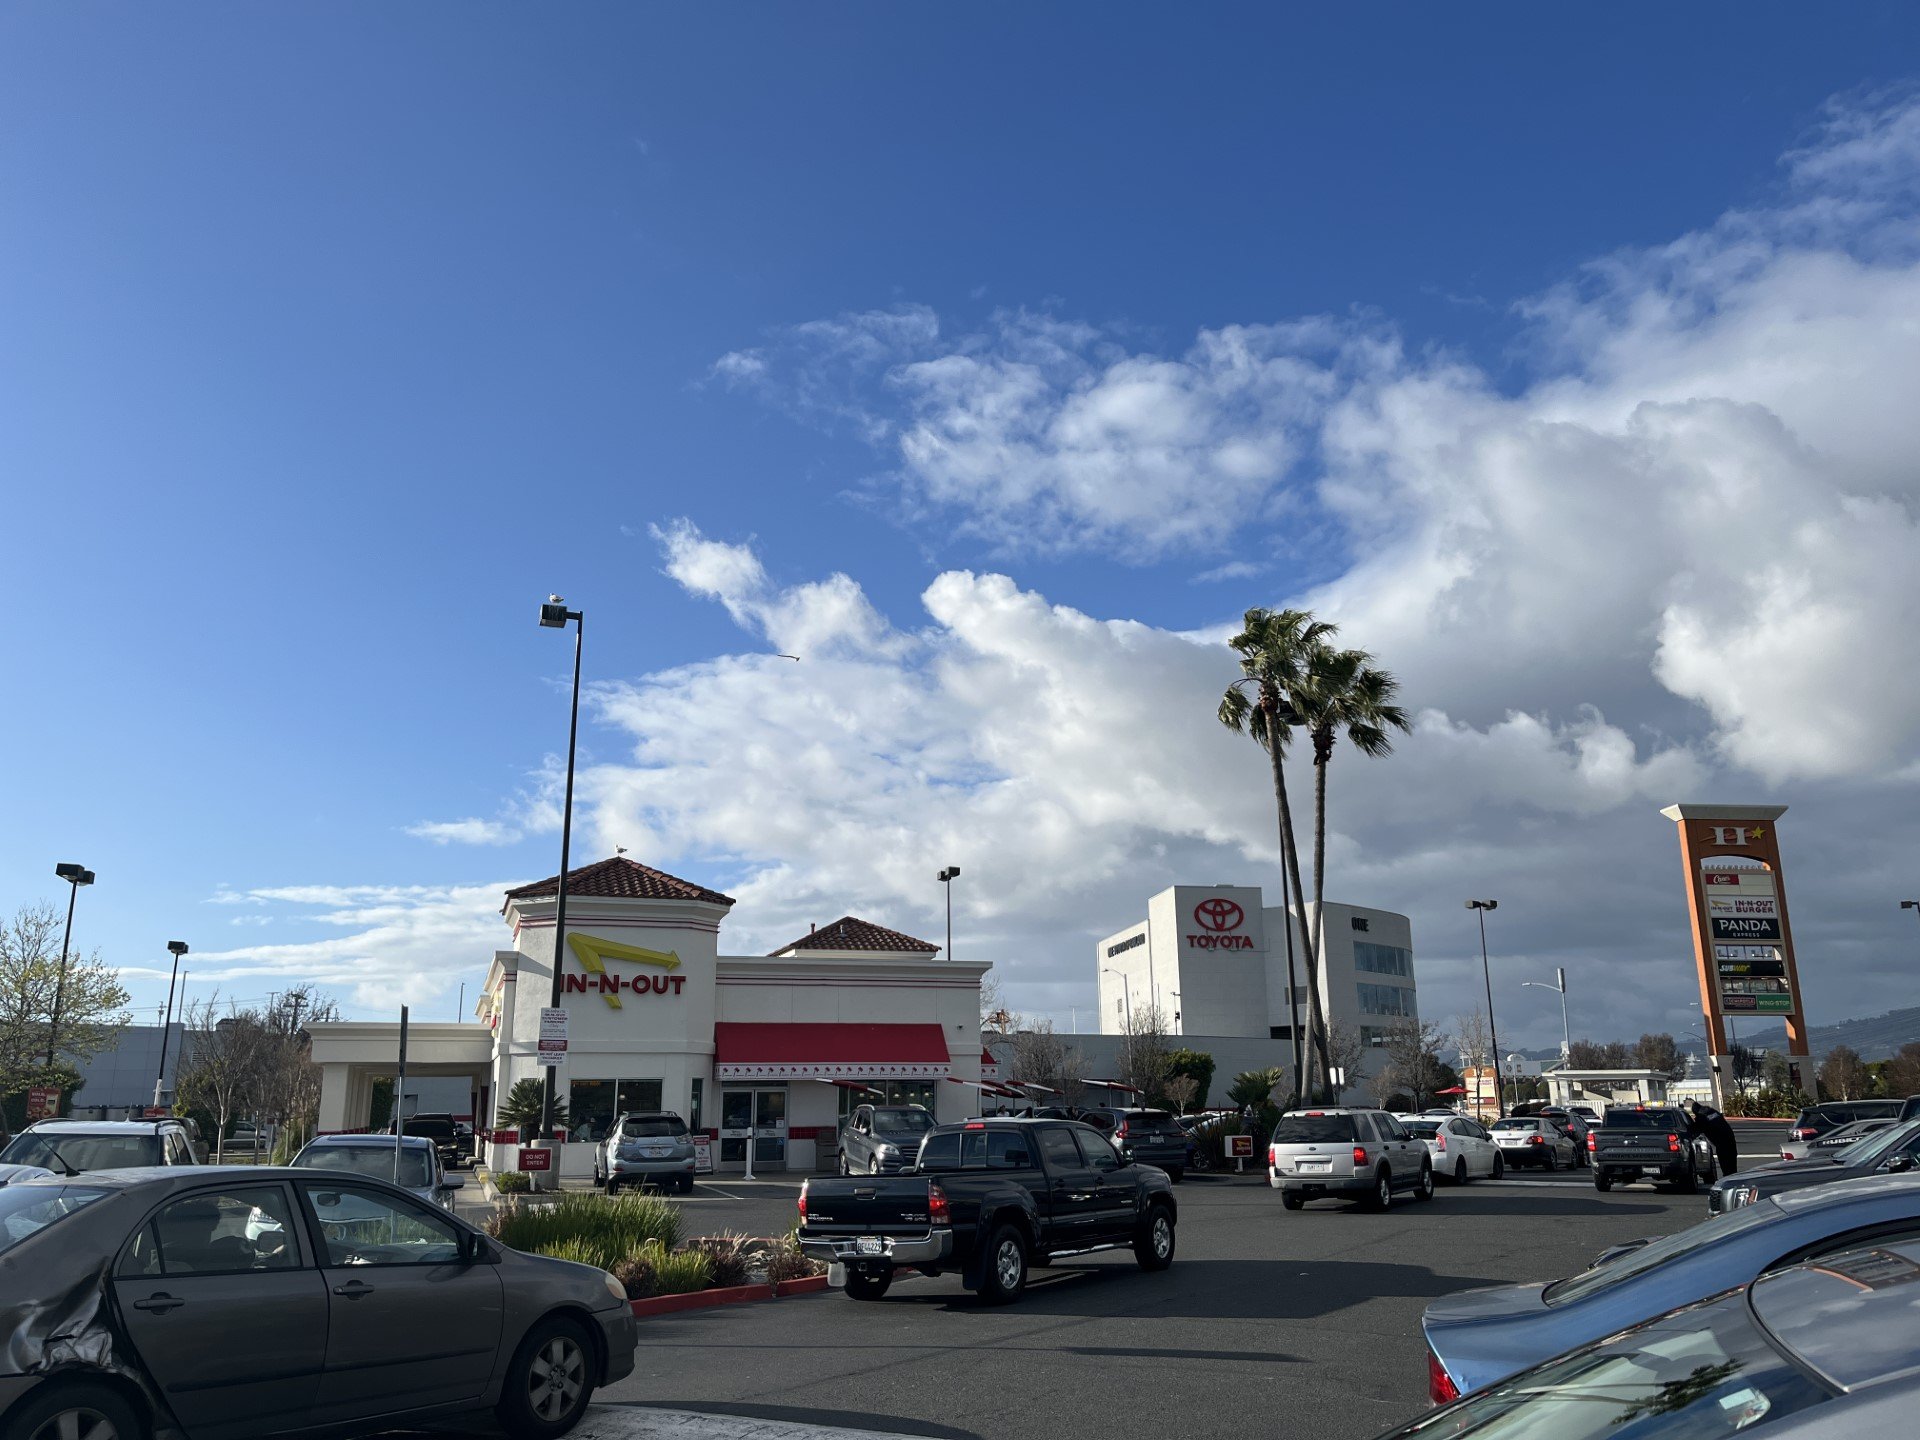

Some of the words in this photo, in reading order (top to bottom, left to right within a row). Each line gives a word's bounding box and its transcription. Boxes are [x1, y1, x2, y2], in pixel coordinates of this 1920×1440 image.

[1719, 920, 1771, 931] PANDA
[1186, 935, 1254, 949] TOYOTA
[560, 973, 687, 995] IN-N-OUT
